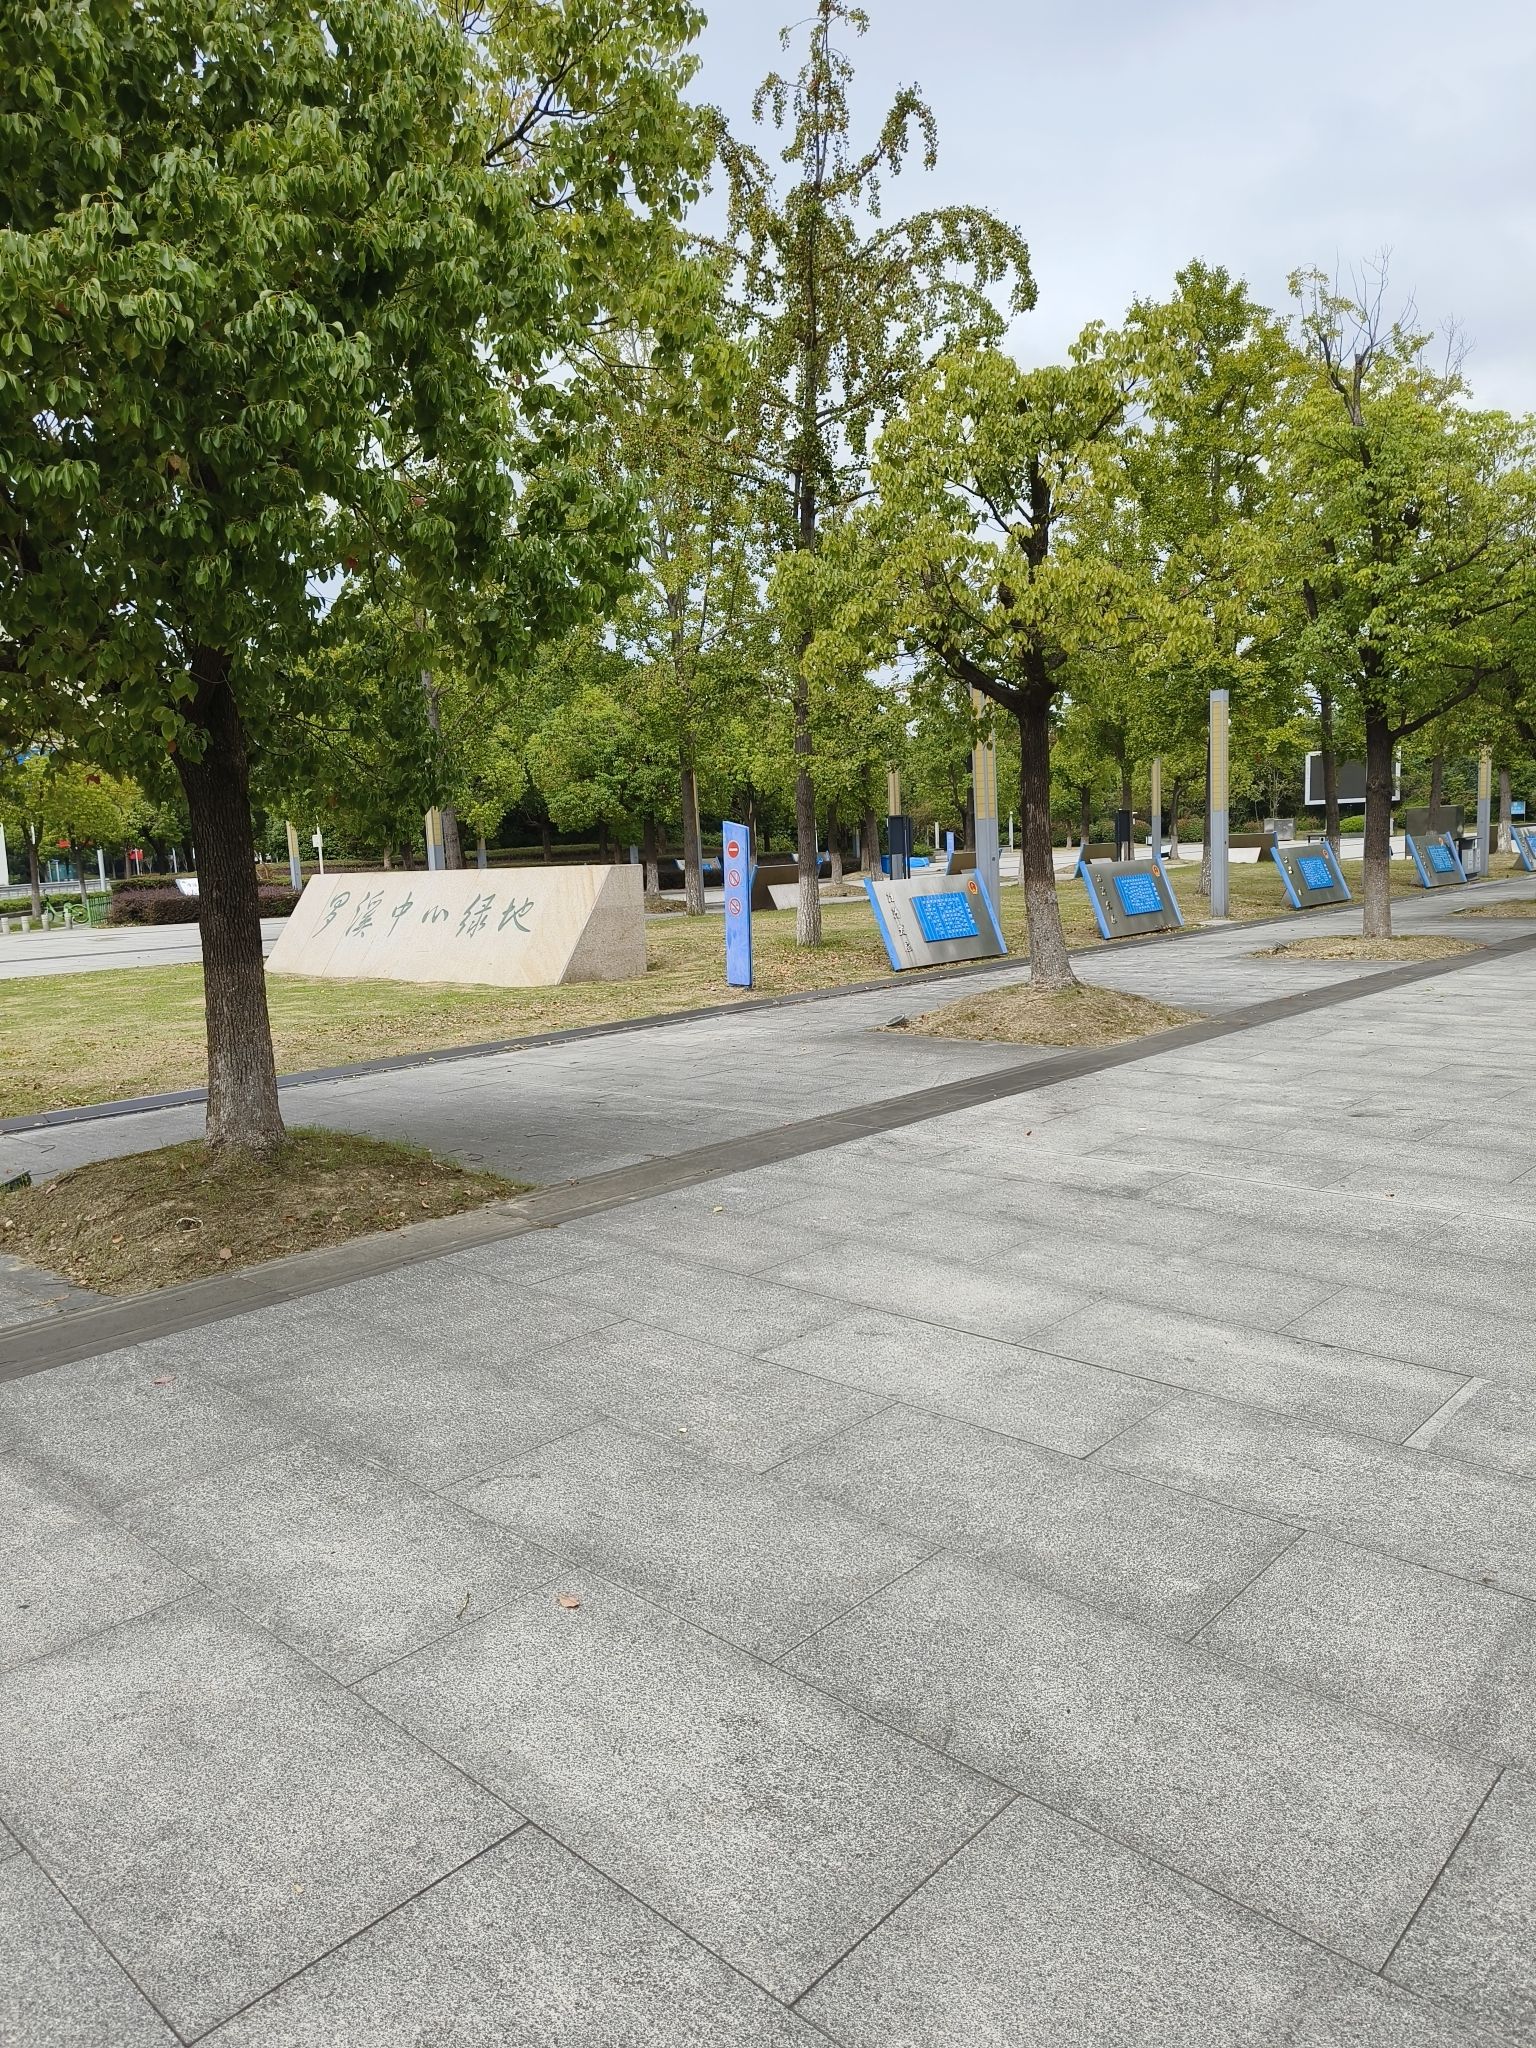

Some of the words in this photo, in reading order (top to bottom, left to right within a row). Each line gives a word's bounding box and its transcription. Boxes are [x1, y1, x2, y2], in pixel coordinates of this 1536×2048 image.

[312, 890, 535, 938] 罗溪中心绿地
